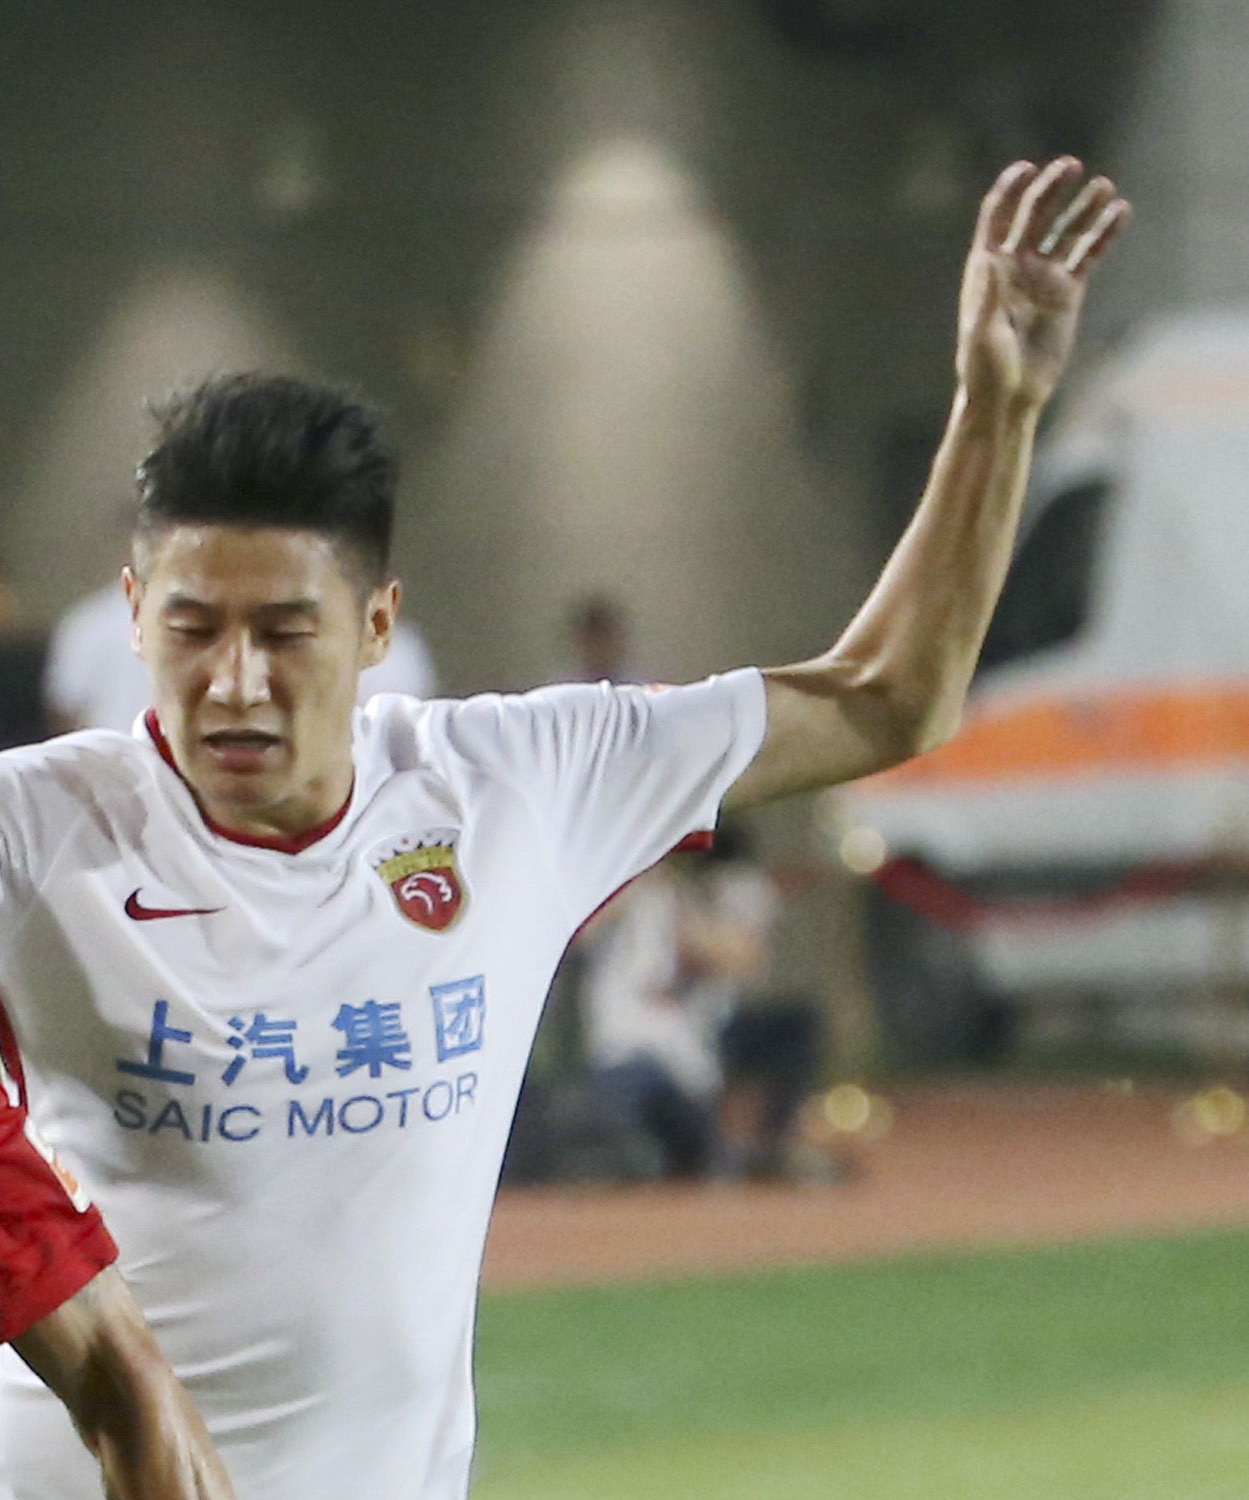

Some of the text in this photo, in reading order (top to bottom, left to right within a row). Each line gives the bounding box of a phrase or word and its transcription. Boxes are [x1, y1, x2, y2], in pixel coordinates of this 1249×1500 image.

[116, 974, 485, 1086] 上汽集团
[113, 1072, 477, 1142] SAIC MOTOR
